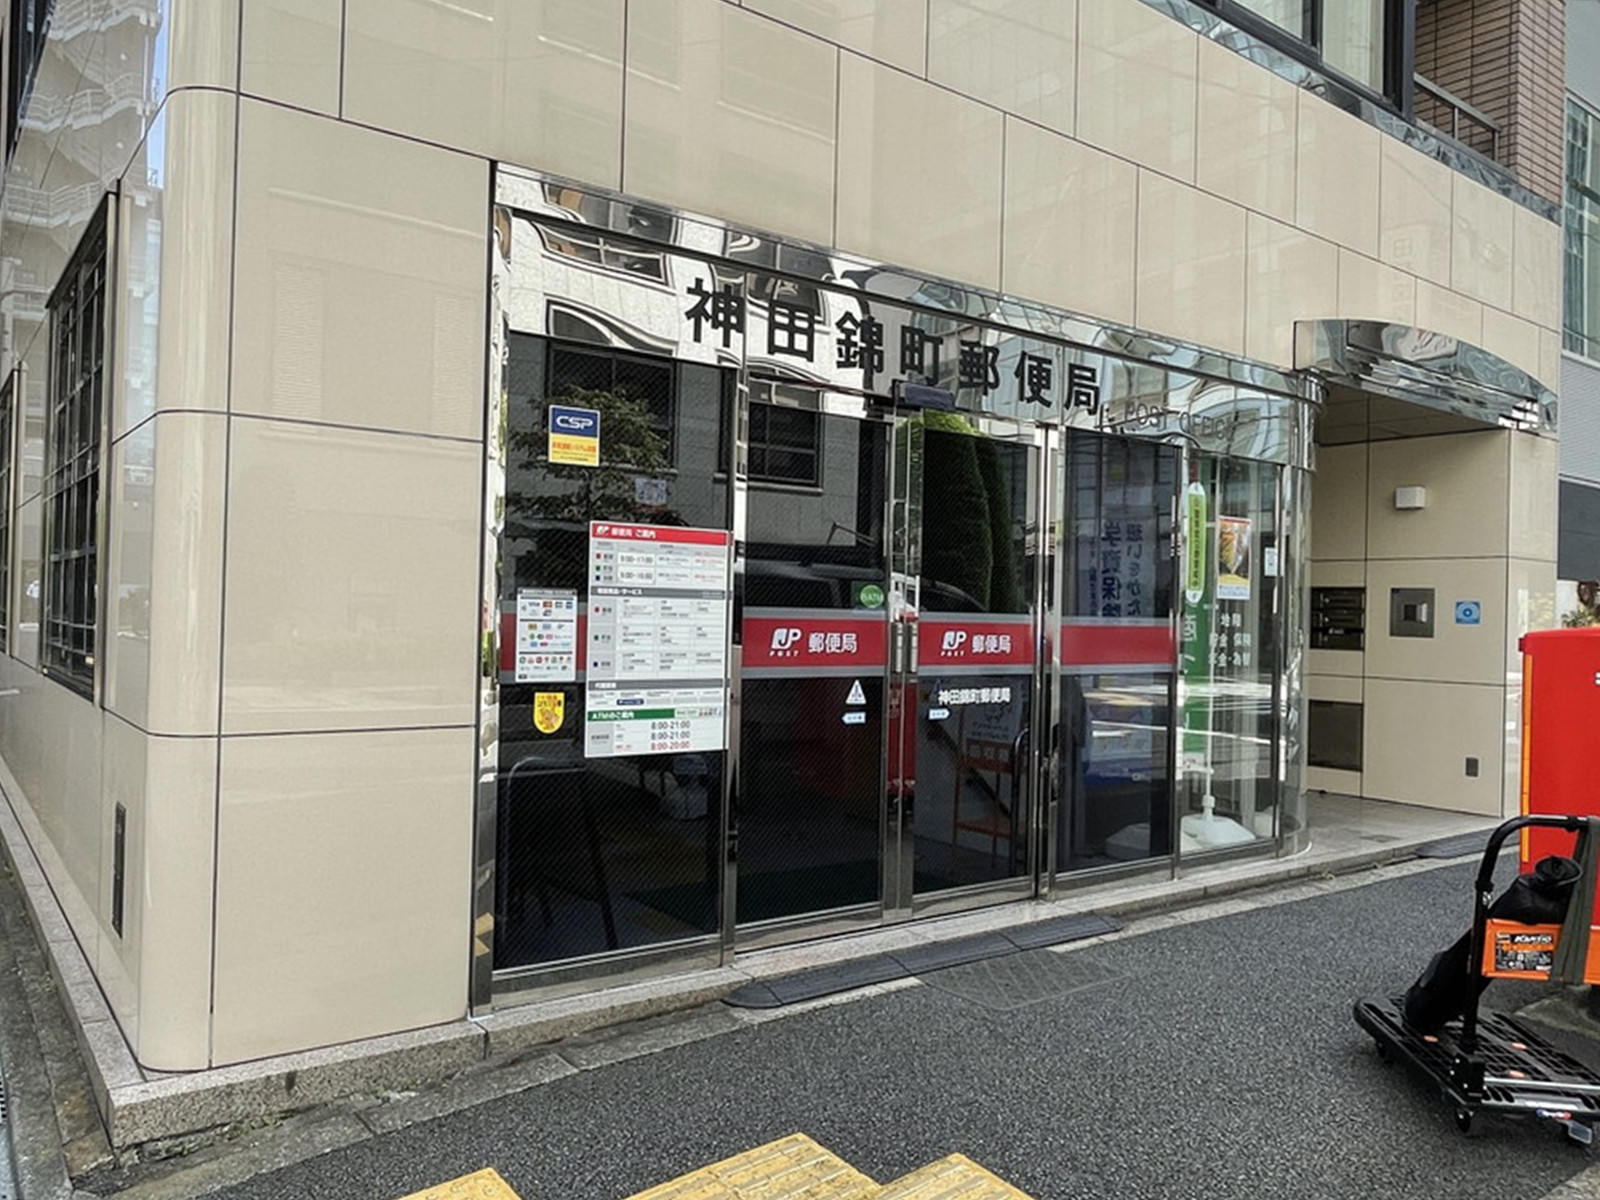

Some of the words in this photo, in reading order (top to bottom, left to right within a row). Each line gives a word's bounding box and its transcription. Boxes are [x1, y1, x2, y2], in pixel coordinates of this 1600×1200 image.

[684, 277, 1101, 416] 神田錦町郵便局
[556, 415, 593, 430] CSP
[808, 633, 858, 654] 郵便局
[971, 635, 1012, 654] 郵便局
